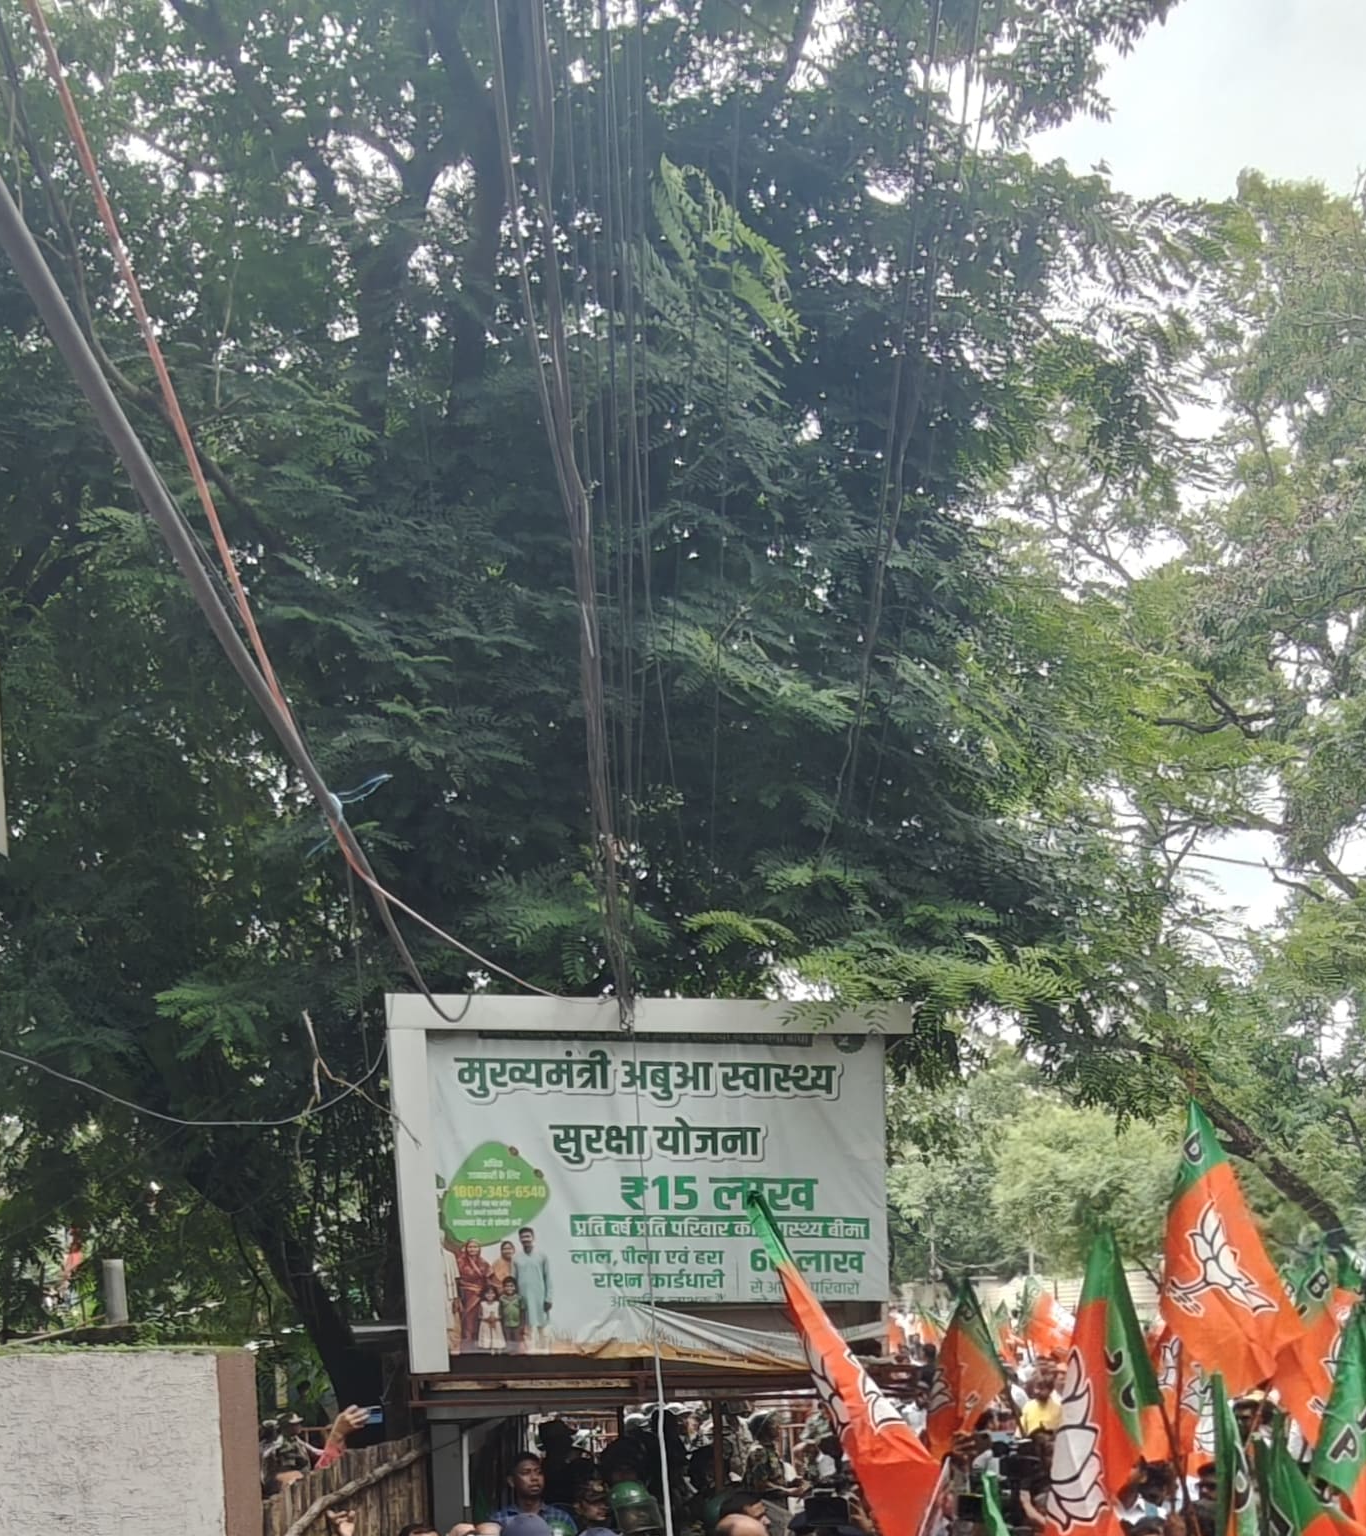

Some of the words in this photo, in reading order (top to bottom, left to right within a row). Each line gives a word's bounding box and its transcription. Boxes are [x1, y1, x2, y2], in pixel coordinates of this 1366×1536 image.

[454, 1050, 611, 1098] मुख्यमंत्री
[621, 1062, 713, 1099] अबुआ
[721, 1062, 837, 1095] स्वास्थ्य
[548, 1124, 648, 1164] सुरक्षा
[655, 1117, 761, 1156] योजना
[620, 1175, 699, 1210] ₹15
[573, 1216, 606, 1236] प्रति
[607, 1216, 633, 1236] वर्ष
[636, 1216, 667, 1236] प्रति
[670, 1216, 728, 1237] परिवार
[827, 1218, 866, 1238] बीमा
[663, 1246, 690, 1264] एवं
[693, 1250, 725, 1265] हरा
